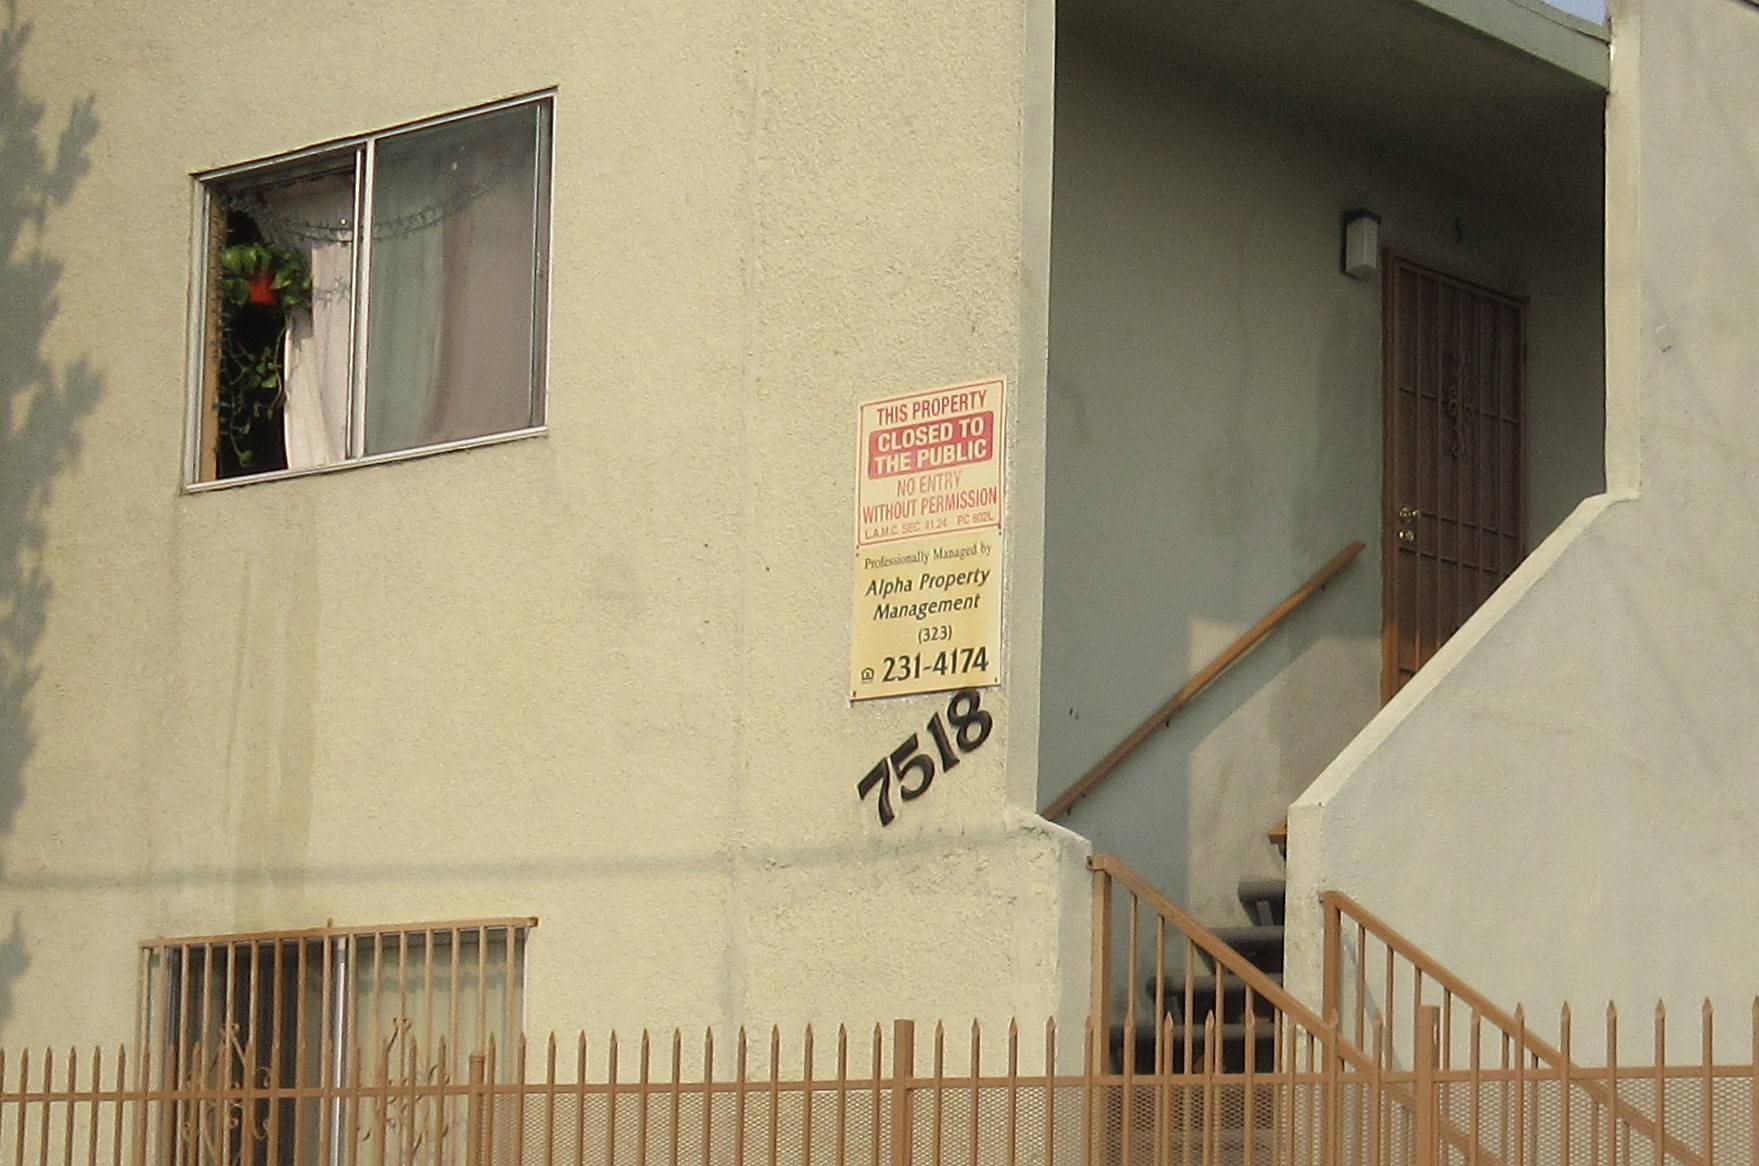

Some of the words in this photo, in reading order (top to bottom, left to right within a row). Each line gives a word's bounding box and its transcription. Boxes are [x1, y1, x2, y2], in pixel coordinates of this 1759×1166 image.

[877, 405, 908, 426] THIS
[912, 389, 987, 420] PROPERTY
[878, 422, 953, 452] CLOSED
[959, 416, 984, 438] TO
[874, 451, 911, 475] THE
[917, 439, 987, 469] PUBLIC
[897, 477, 915, 497] NO
[919, 470, 961, 494] ENTRY
[863, 499, 917, 524] WITHOUT
[921, 486, 998, 516] PERMISSION
[957, 515, 970, 526] PC
[864, 550, 929, 570] Professionally
[933, 543, 977, 560] Managed
[980, 541, 992, 556] by
[865, 576, 913, 599] Alpha
[919, 568, 991, 592] Property
[873, 593, 981, 621] Management
[918, 624, 953, 644] (323)
[882, 646, 989, 683] 231-4174
[857, 687, 993, 828] 7518
